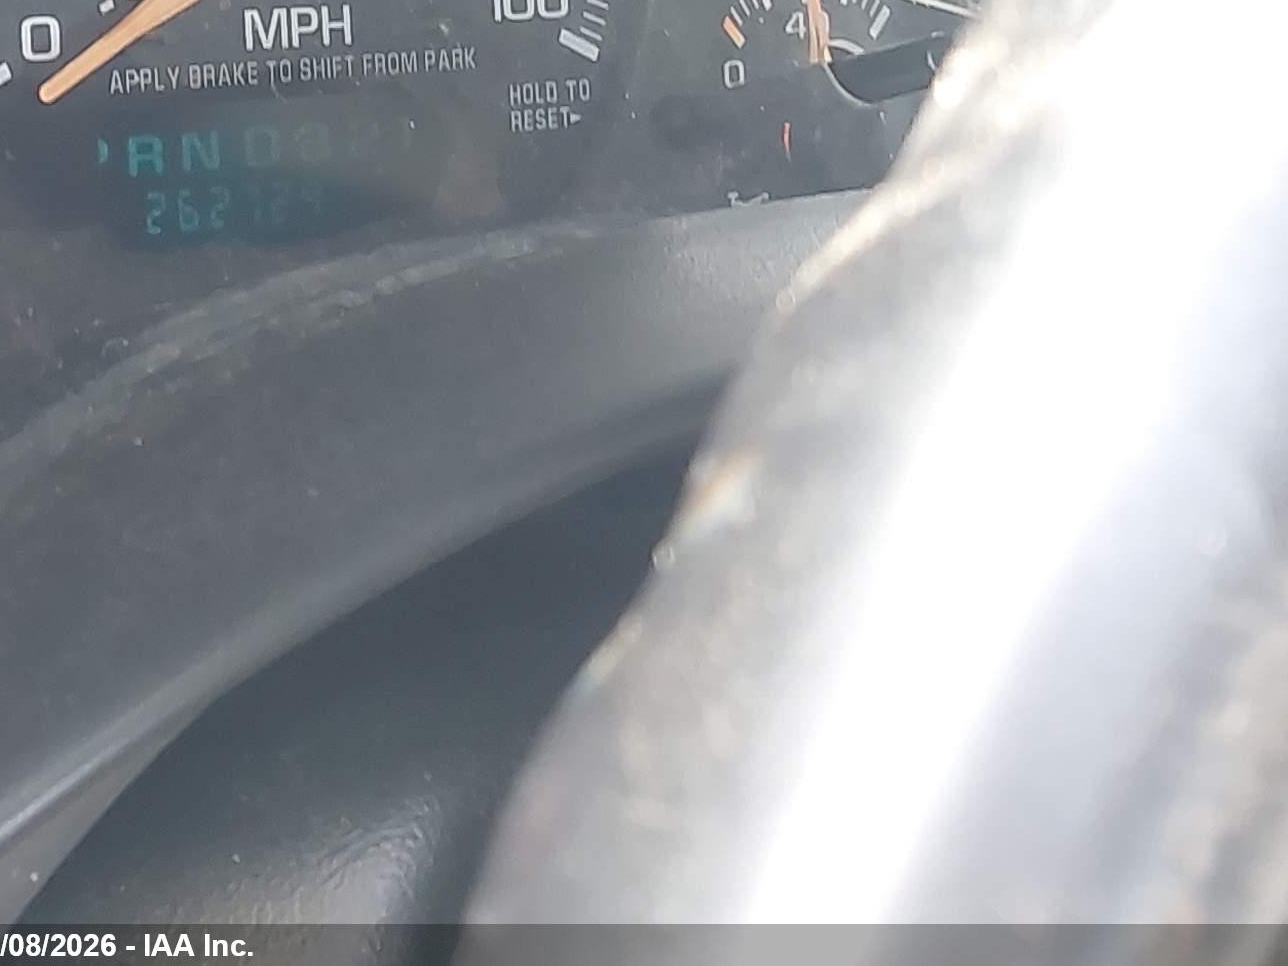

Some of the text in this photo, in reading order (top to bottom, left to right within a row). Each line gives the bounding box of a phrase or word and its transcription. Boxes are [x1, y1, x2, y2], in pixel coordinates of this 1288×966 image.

[20, 15, 61, 62] 0
[243, 4, 353, 52] MPH
[110, 46, 476, 94] APPLY BRAKE TO SHIFT FROM PARK
[723, 59, 745, 89] 0
[509, 78, 590, 106] HOLD TO
[511, 106, 570, 132] RESET
[181, 130, 221, 171] N
